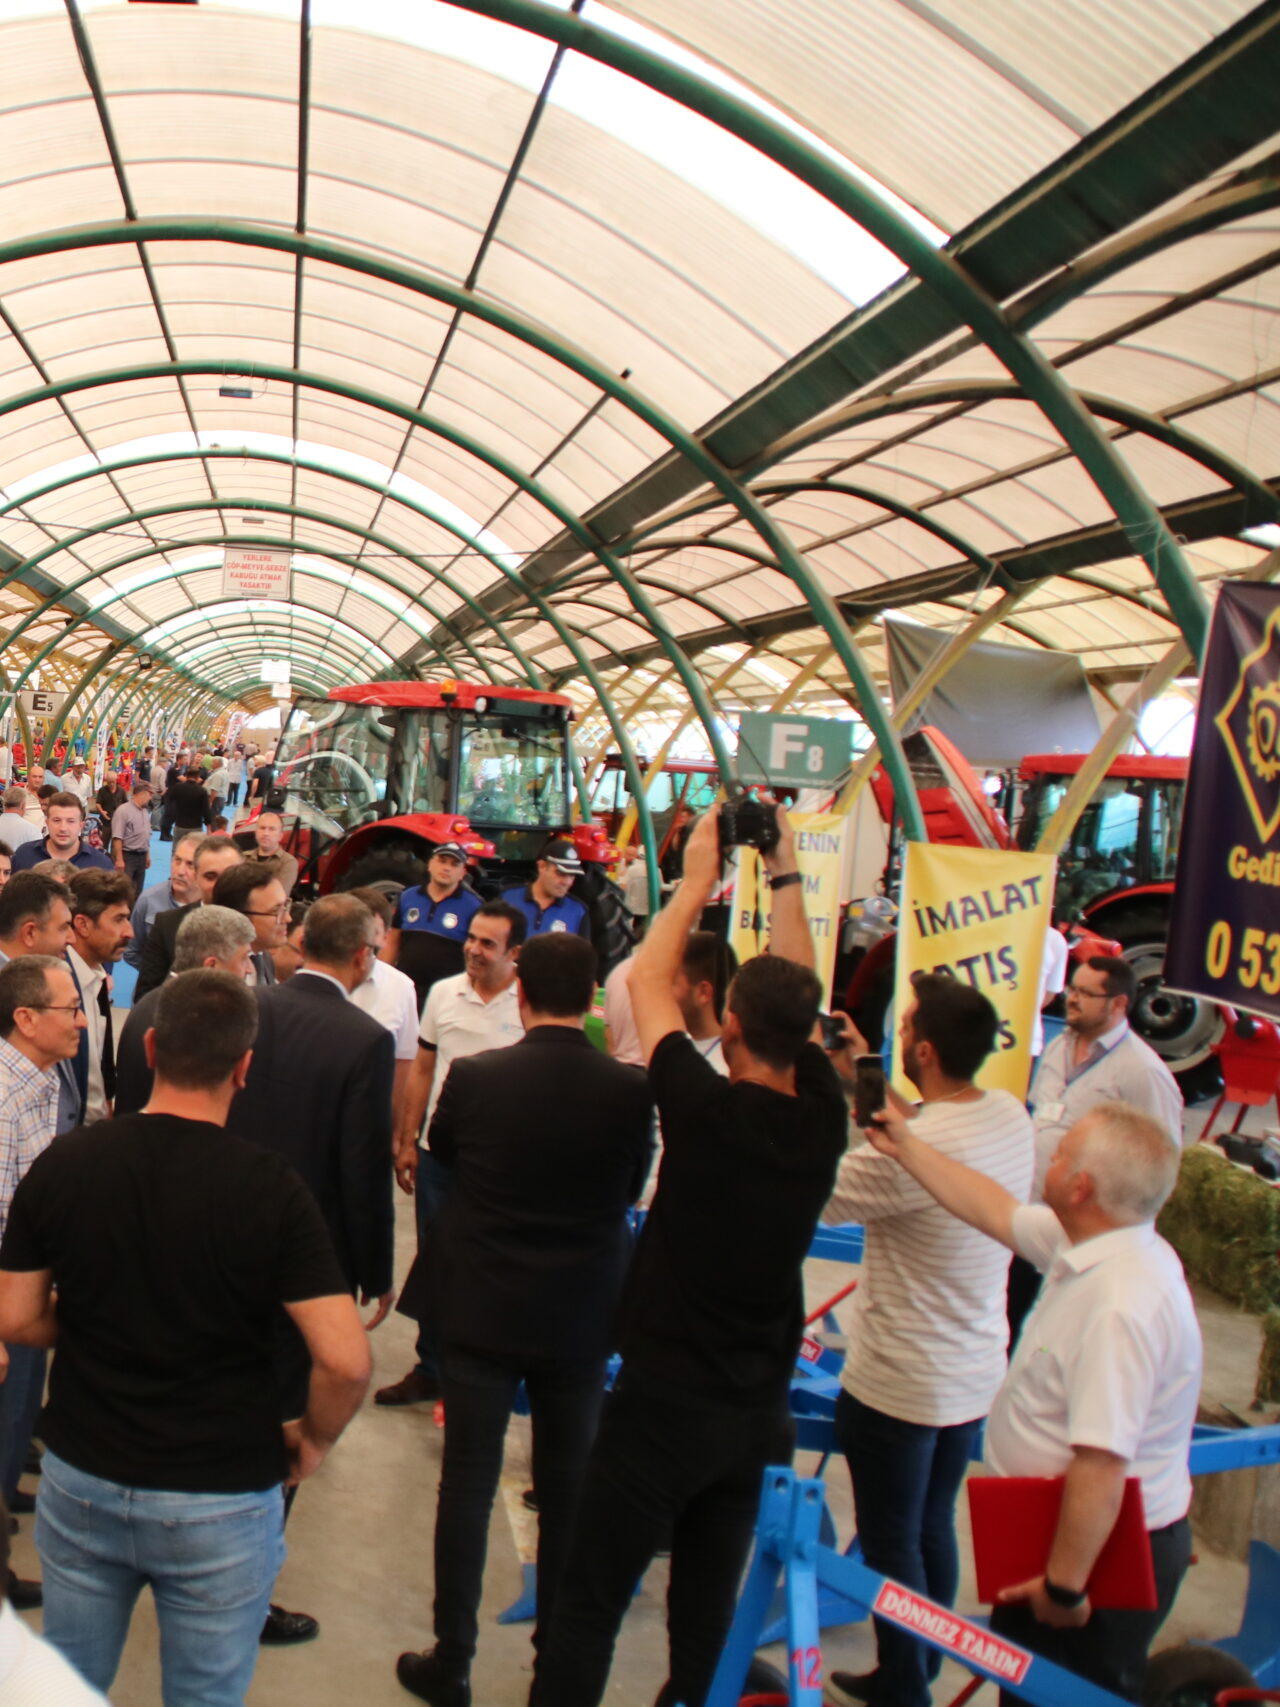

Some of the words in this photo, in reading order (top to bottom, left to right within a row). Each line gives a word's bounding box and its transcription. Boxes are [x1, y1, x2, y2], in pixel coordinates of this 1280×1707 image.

[912, 874, 1042, 939] İMALAT
[880, 1590, 959, 1644] DÖNMEZ
[959, 1633, 1022, 1678] TARIM
[790, 1646, 823, 1690] 12
